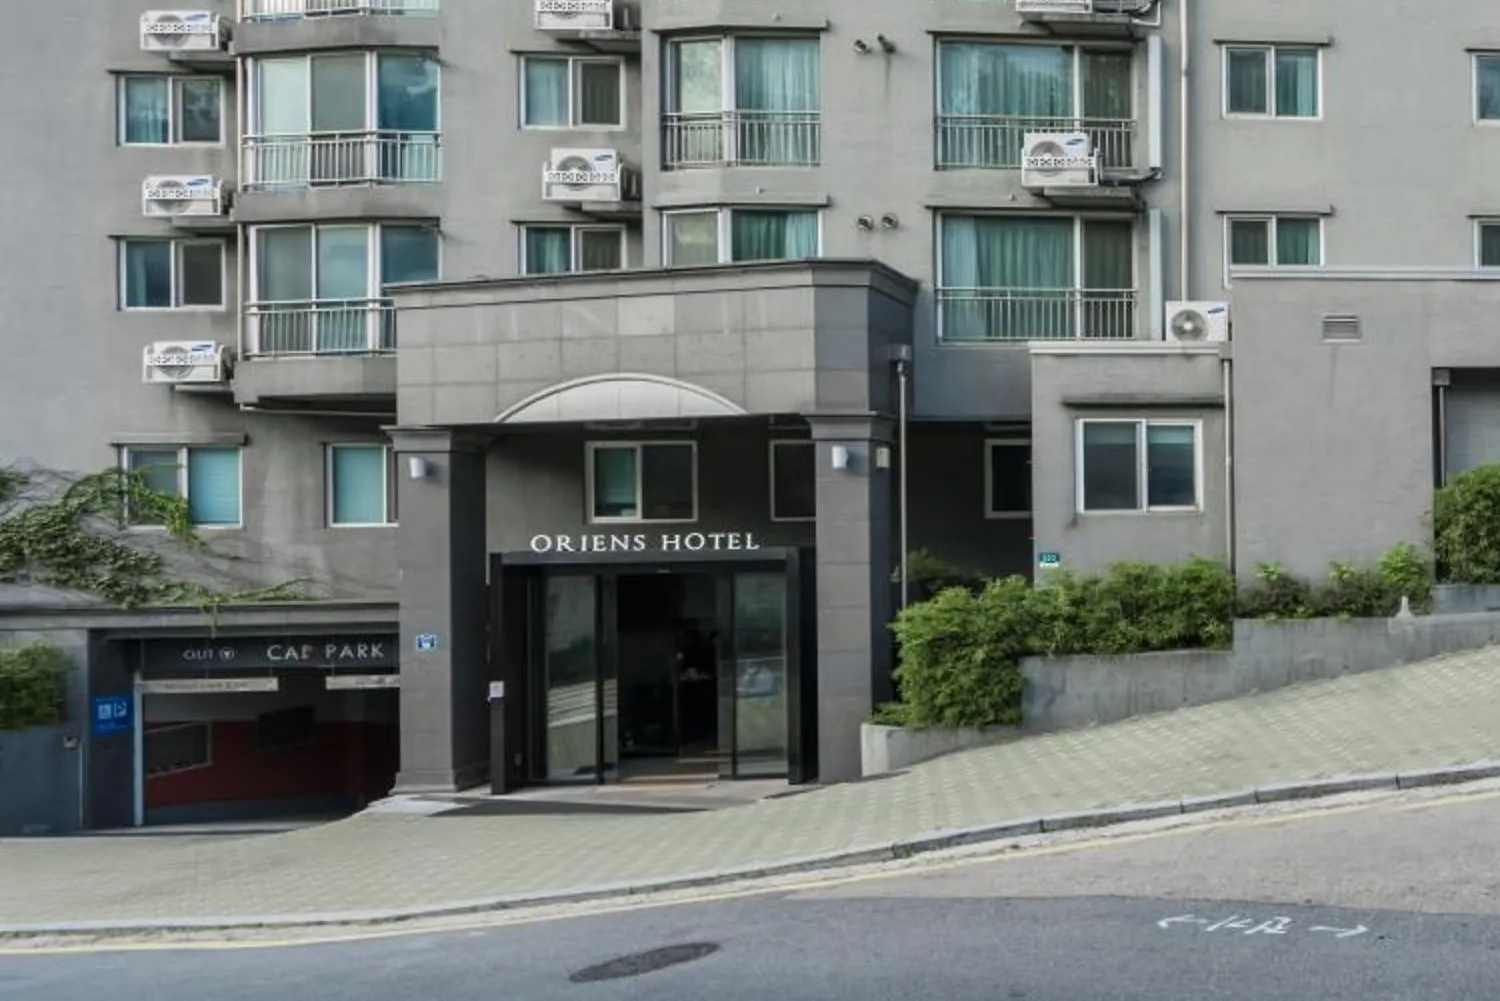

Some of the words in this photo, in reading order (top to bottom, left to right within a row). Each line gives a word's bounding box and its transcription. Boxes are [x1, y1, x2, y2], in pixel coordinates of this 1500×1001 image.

[530, 534, 645, 553] ORIENS
[661, 532, 760, 551] HOTEL
[325, 642, 385, 659] PARK
